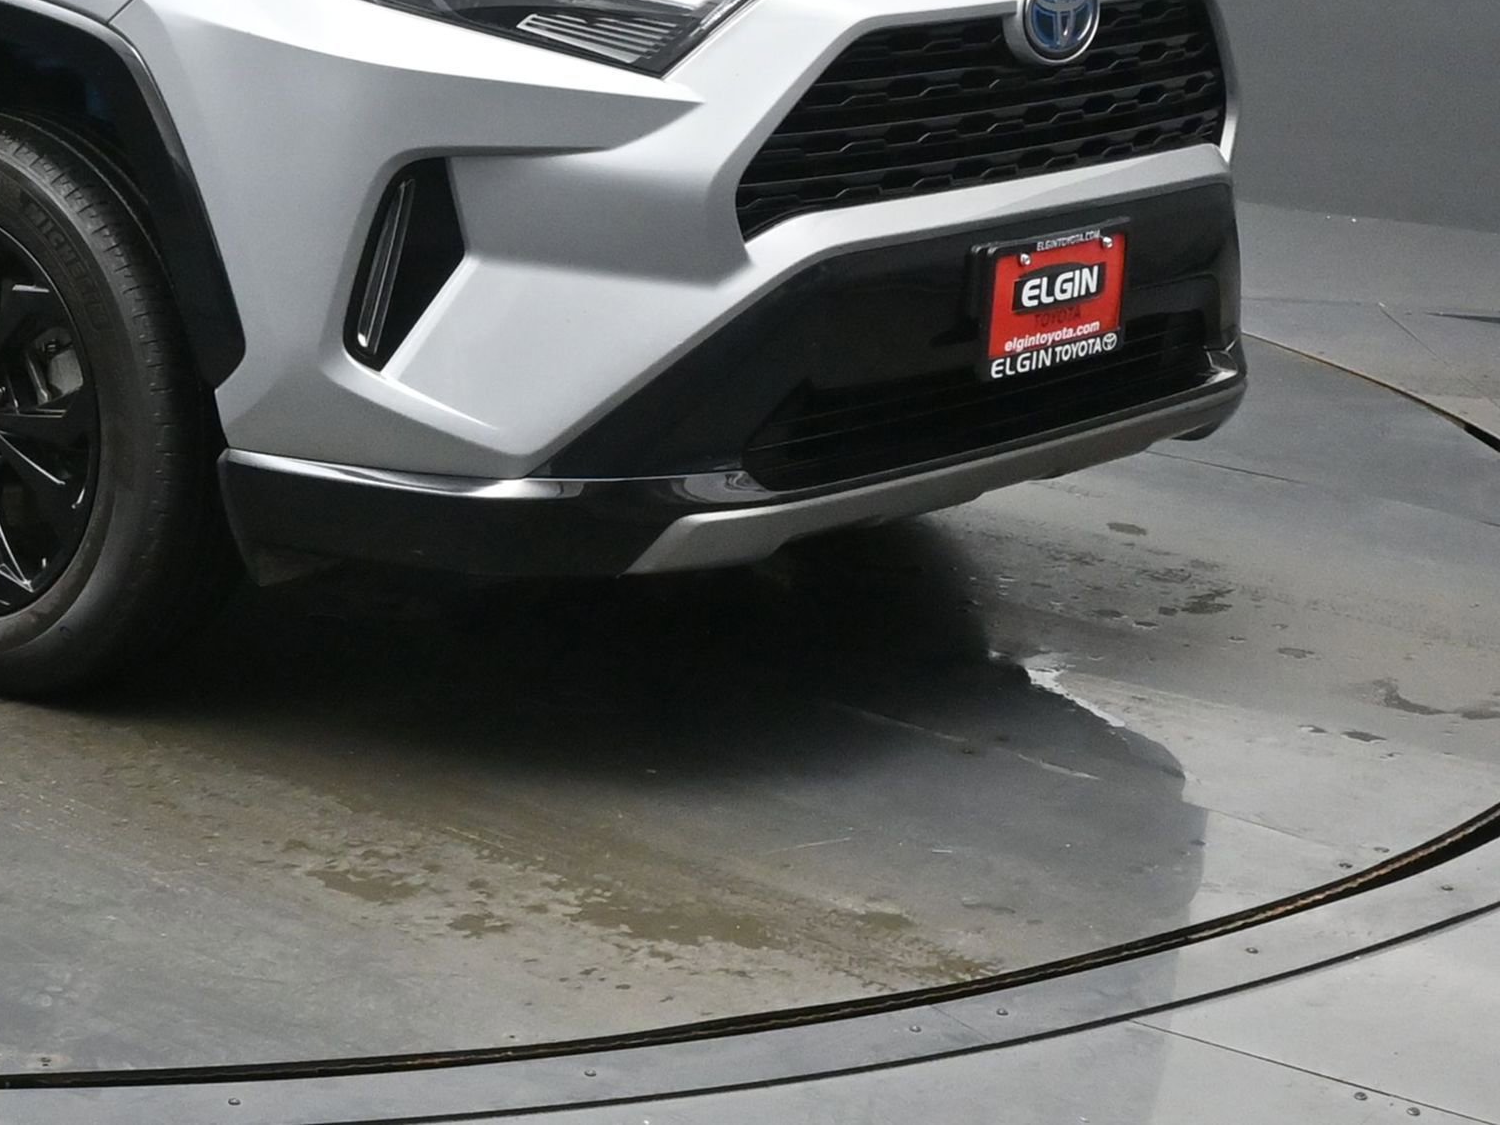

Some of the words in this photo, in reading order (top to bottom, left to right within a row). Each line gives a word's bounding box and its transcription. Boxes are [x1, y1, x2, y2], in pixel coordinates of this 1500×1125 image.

[1021, 265, 1099, 307] ELGIN
[1034, 306, 1082, 327] TOYOTA
[1004, 321, 1100, 353] elgintoyota.com
[990, 347, 1052, 379] ELGIN
[1054, 336, 1102, 363] TOYOTA
